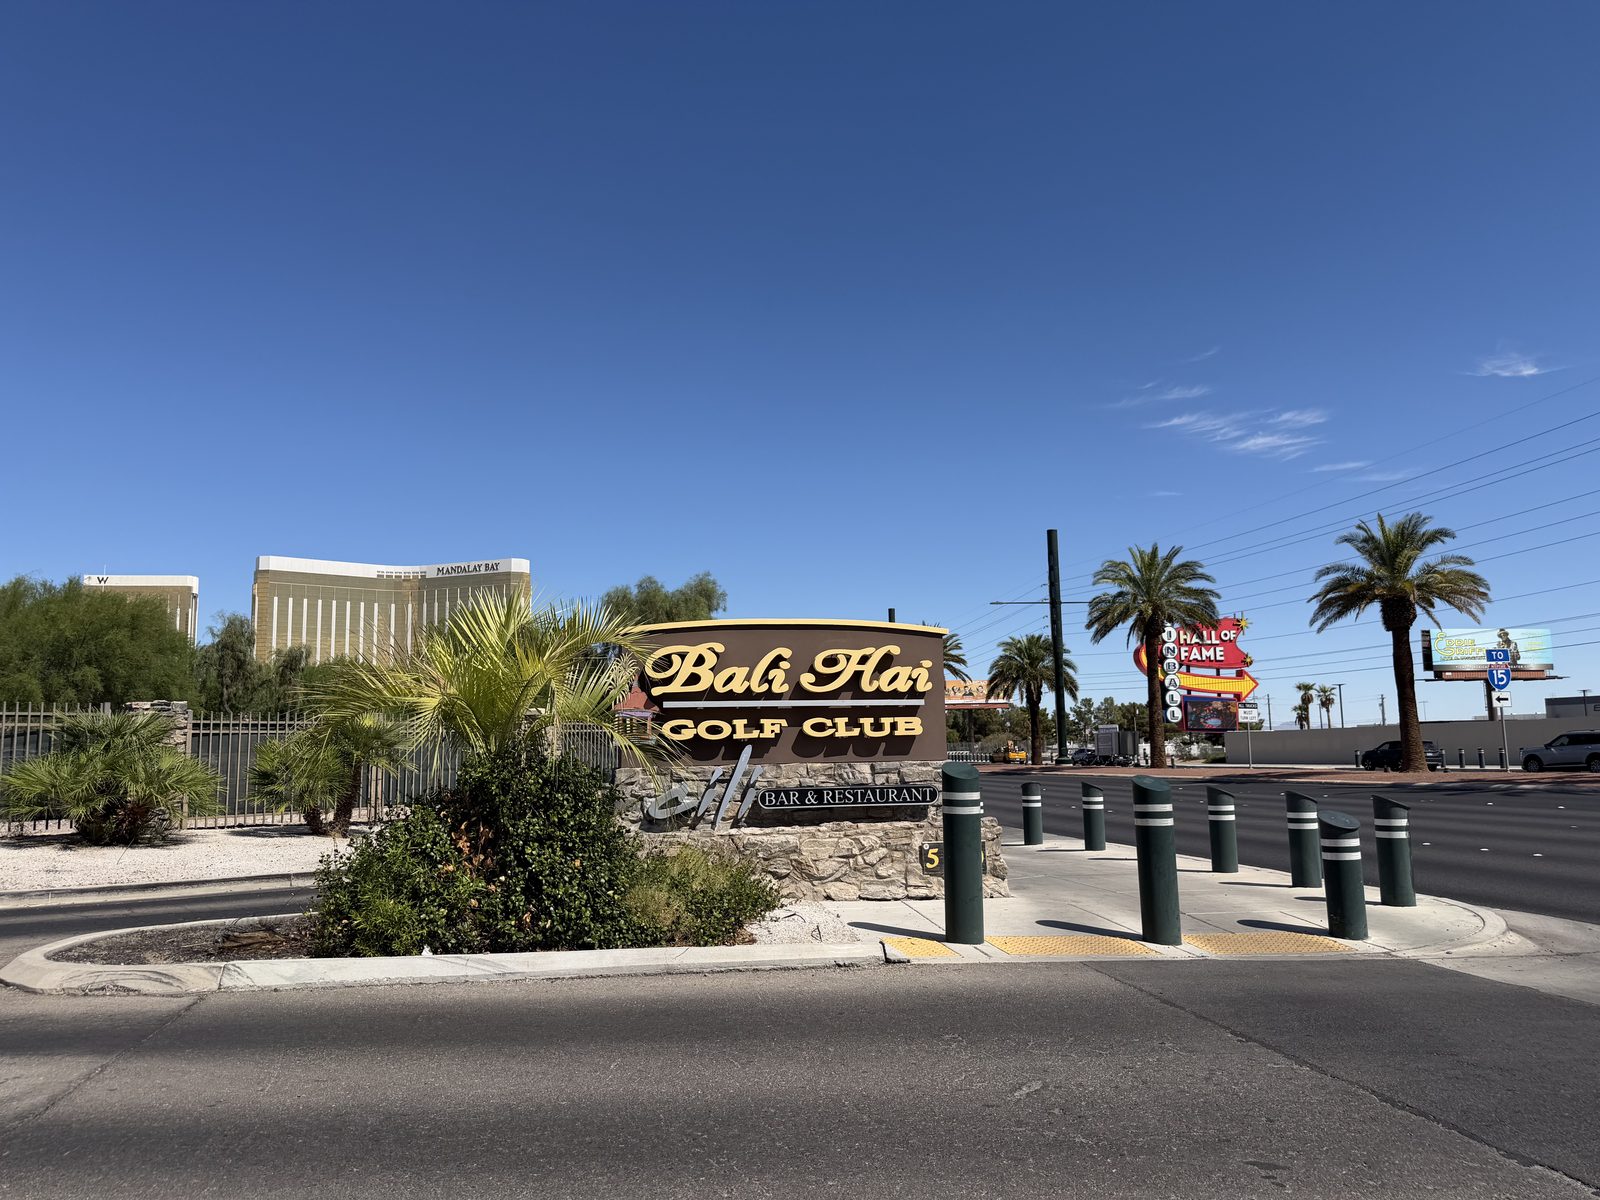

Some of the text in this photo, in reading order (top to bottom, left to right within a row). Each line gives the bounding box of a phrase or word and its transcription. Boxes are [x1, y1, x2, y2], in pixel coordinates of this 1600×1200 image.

[436, 562, 500, 576] MANDALAY BAY
[97, 576, 109, 584] W
[1180, 630, 1237, 644] HALL OF
[1181, 646, 1225, 660] FAME
[1491, 651, 1504, 660] TO
[644, 642, 933, 695] Bali Hai
[1163, 627, 1181, 721] INBALL
[1493, 669, 1506, 685] 15
[662, 716, 924, 741] GOLF CLUB
[764, 786, 934, 806] BAR & RESTAURANT
